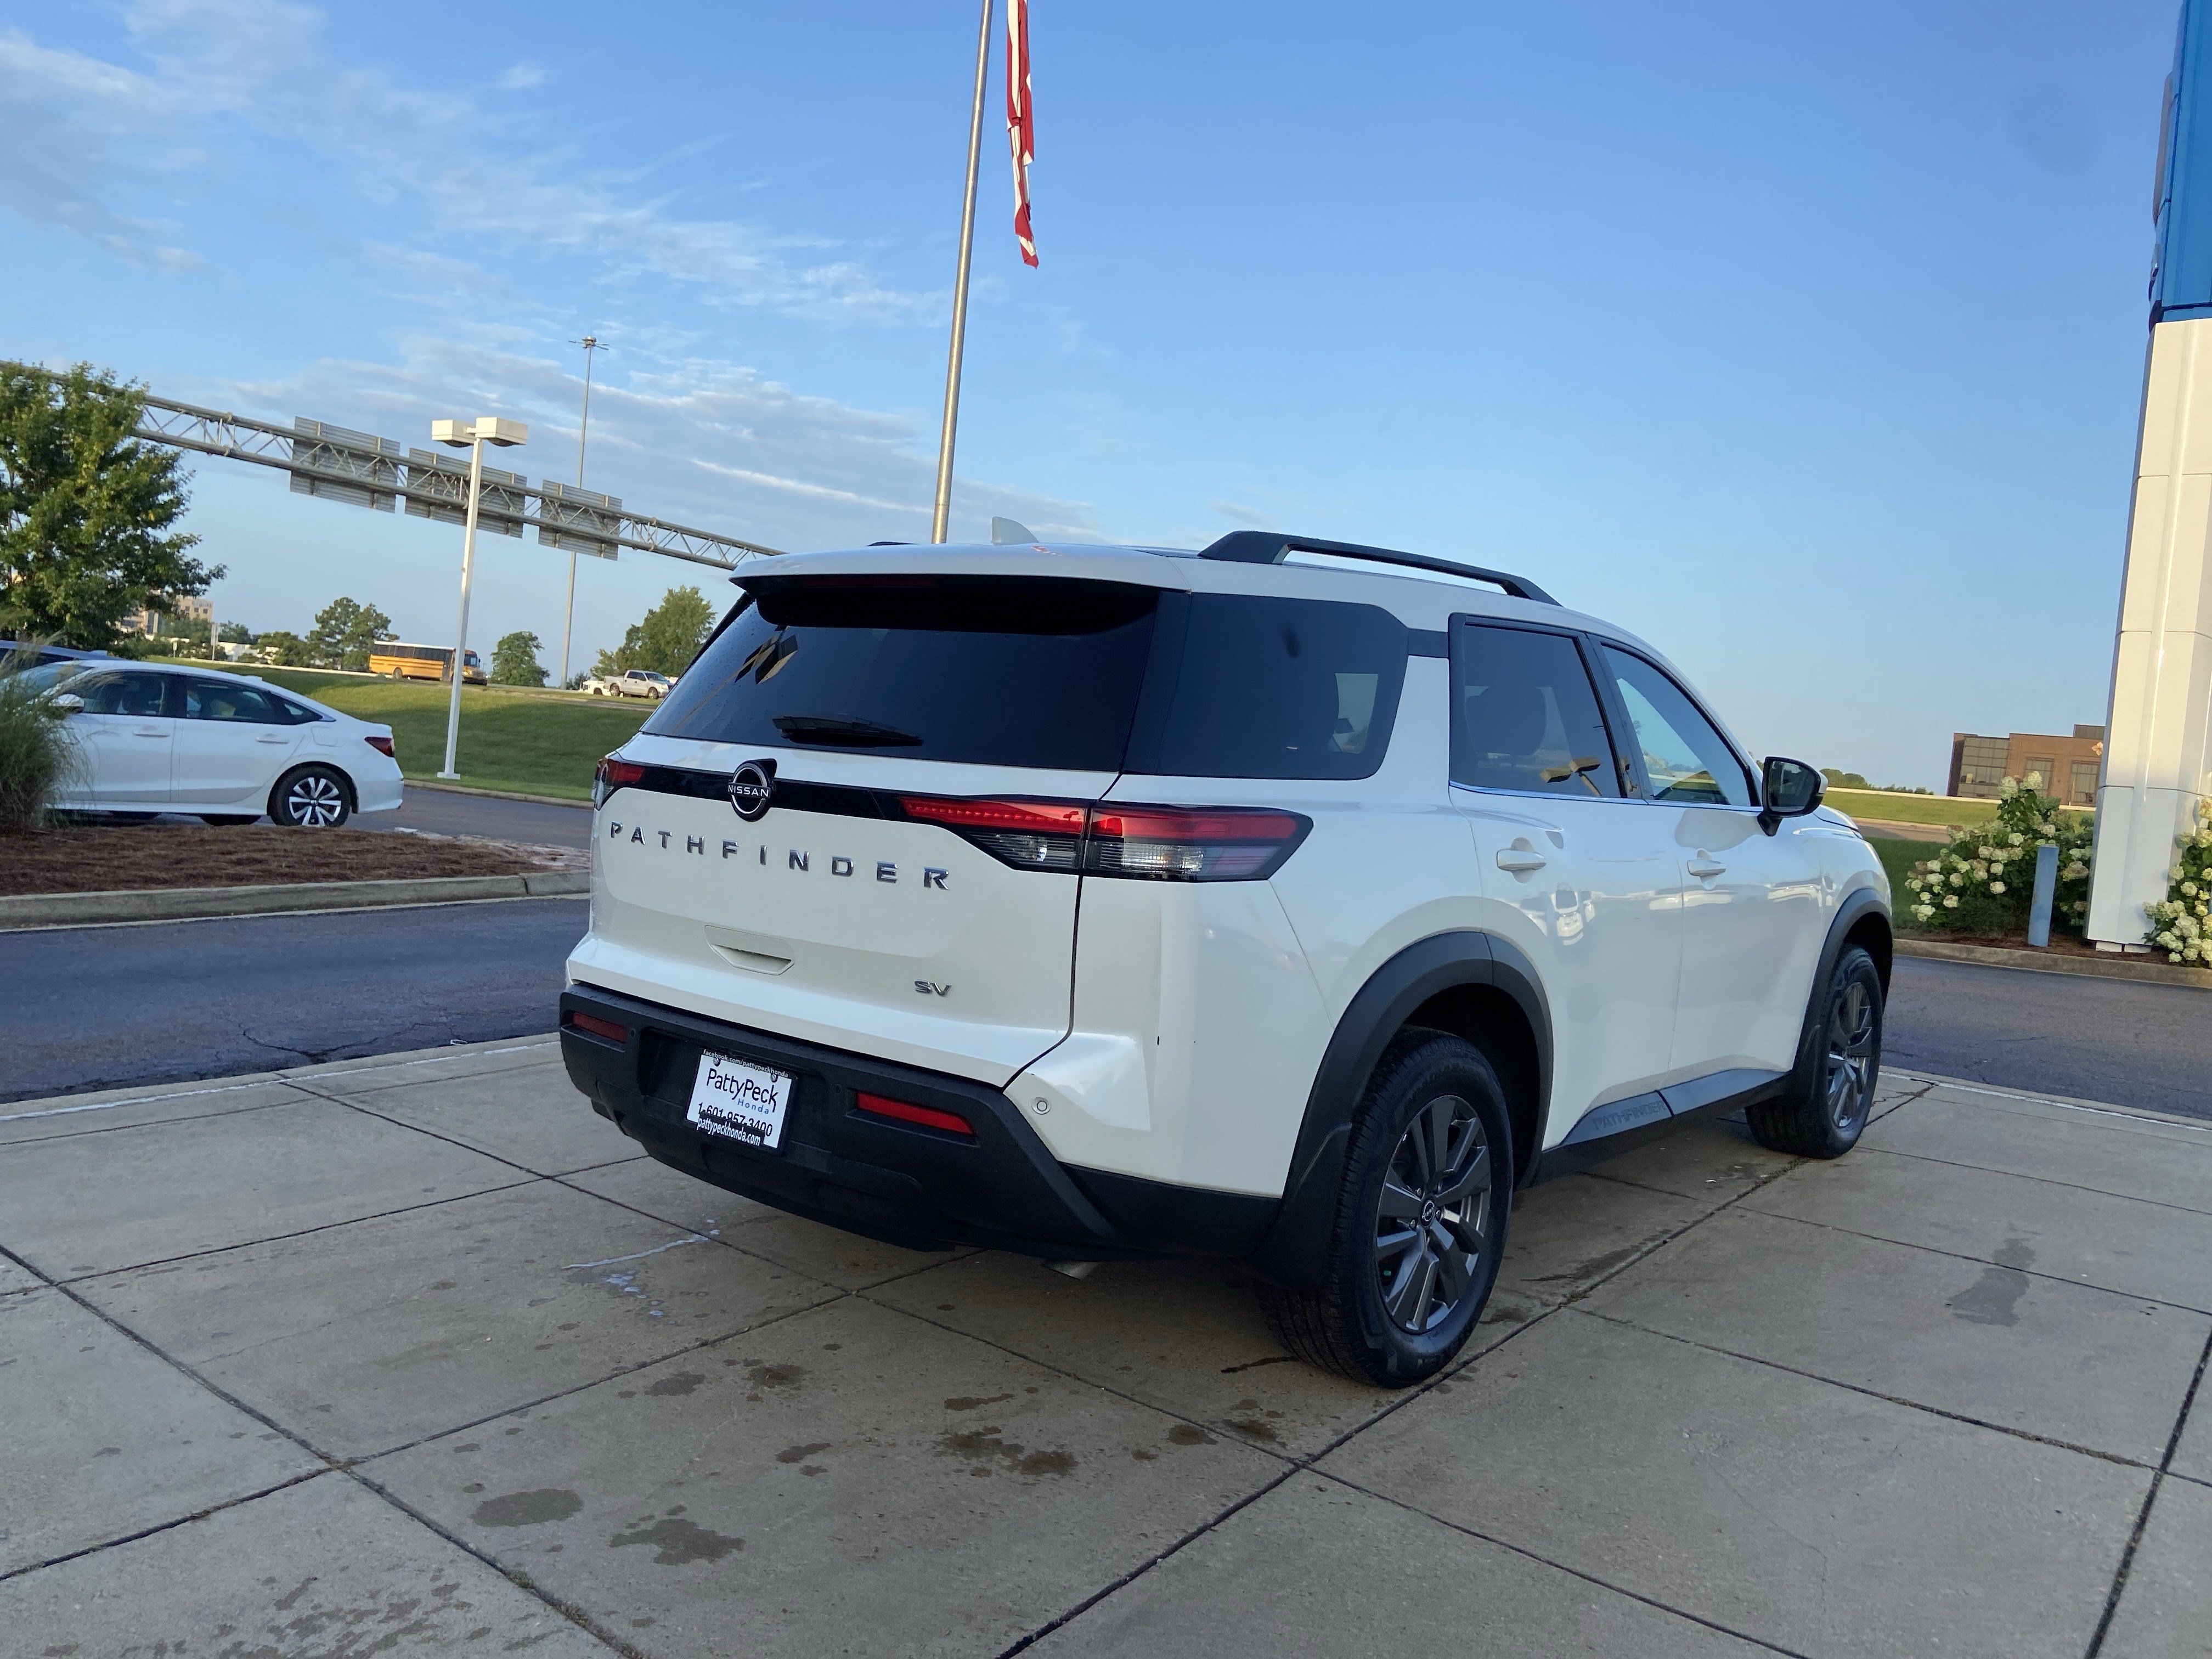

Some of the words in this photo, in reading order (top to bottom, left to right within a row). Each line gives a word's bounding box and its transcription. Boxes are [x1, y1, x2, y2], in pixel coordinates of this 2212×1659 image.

[727, 784, 769, 797] NISSAN
[610, 821, 950, 890] PATHFINDER
[915, 979, 952, 997] SV
[703, 1049, 788, 1077] facebook.com/pattypeckhonda
[737, 1098, 769, 1114] Honda
[1592, 1101, 1668, 1130] PATHFINDER
[697, 1117, 760, 1146] pattypeckhonda.com
